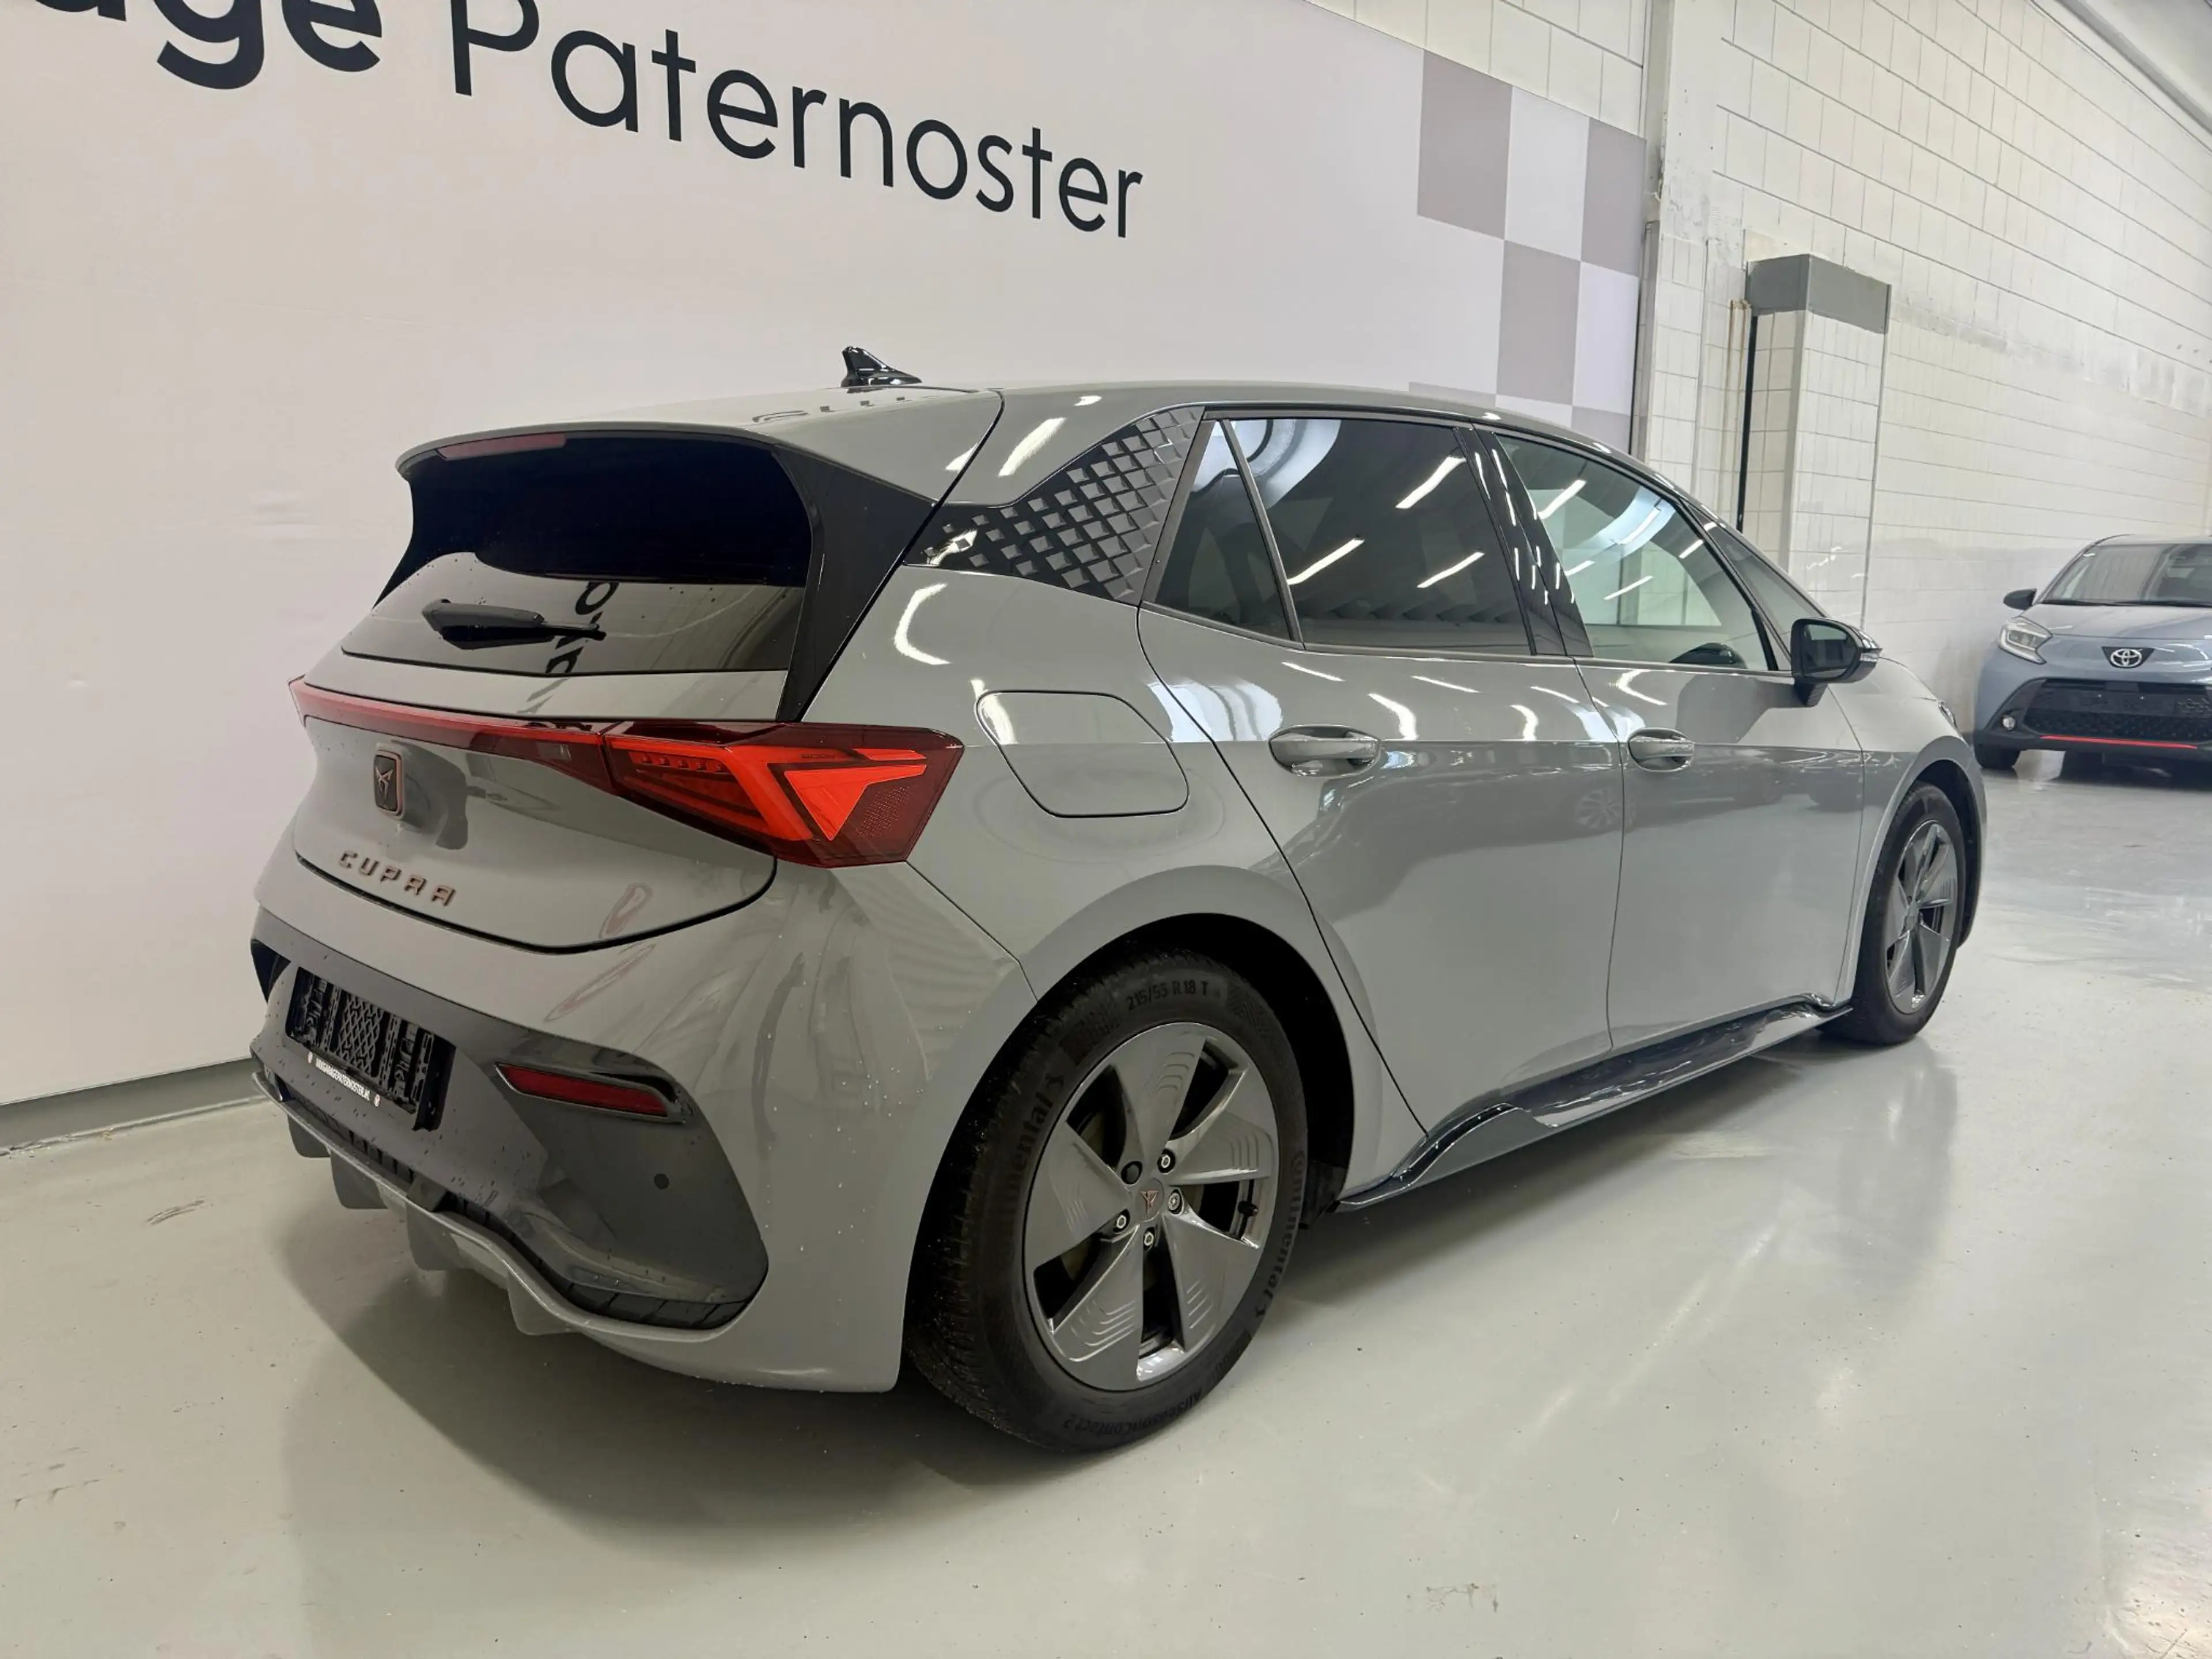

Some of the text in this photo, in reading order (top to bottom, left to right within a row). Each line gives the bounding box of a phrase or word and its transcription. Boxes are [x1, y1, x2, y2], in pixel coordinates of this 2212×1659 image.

[451, 0, 1143, 238] Paternoster
[338, 850, 457, 907] CUPRA
[1126, 982, 1168, 1011] 215/55
